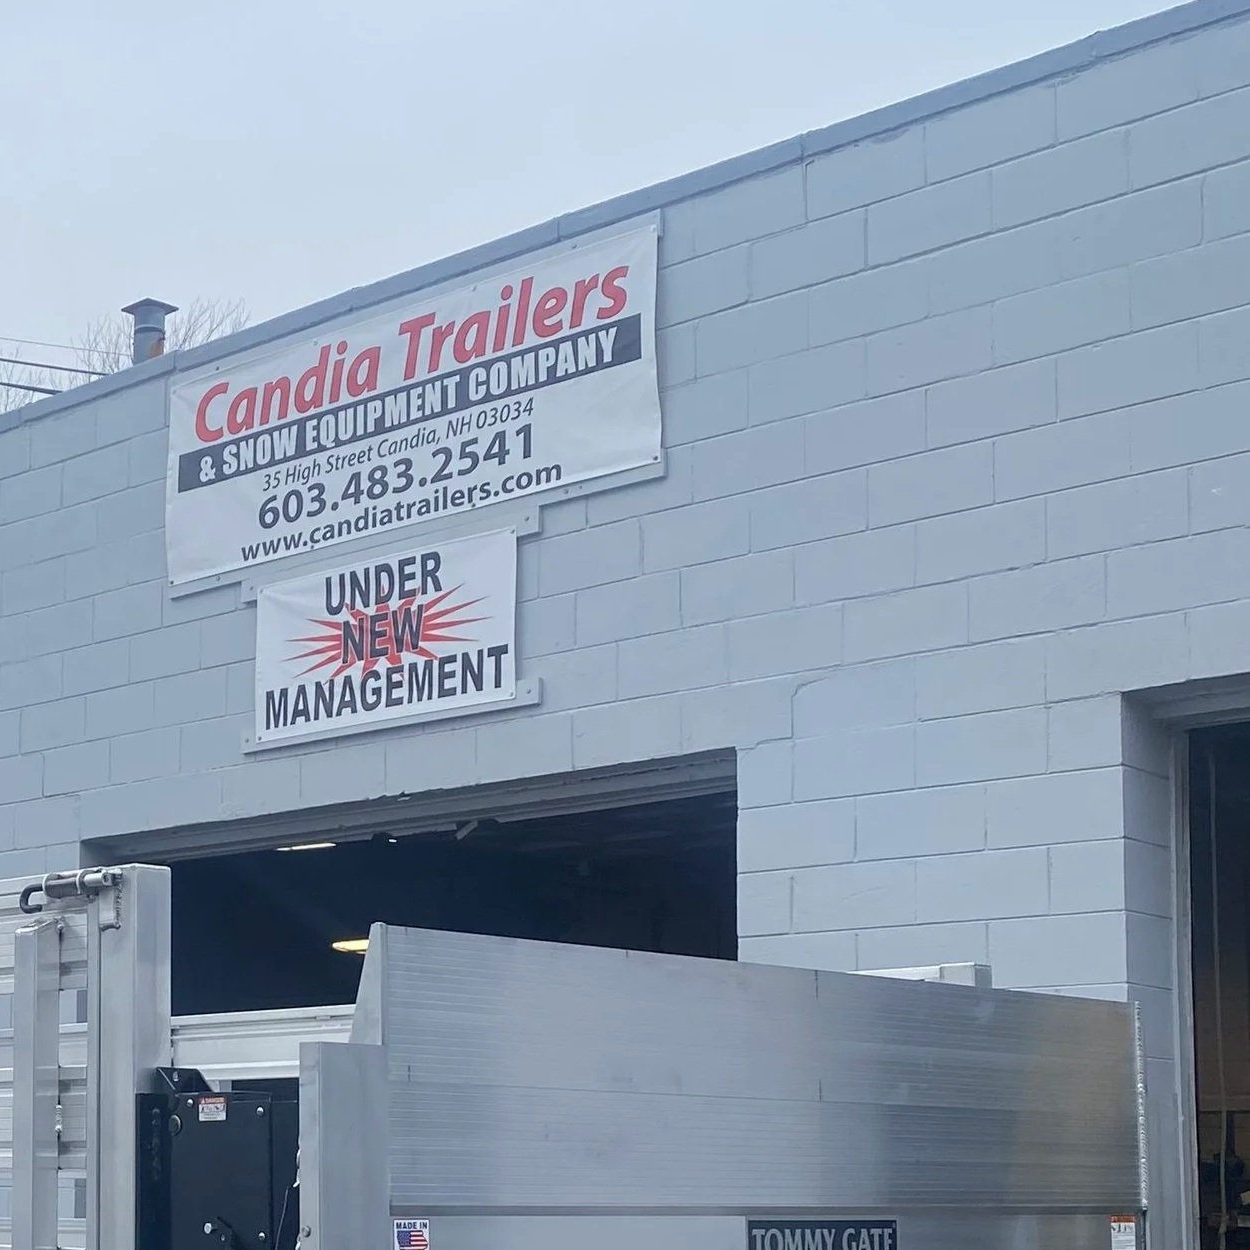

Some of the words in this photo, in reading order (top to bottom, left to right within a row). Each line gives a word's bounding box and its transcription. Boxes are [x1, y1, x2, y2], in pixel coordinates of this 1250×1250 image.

[195, 340, 382, 443] Candia
[398, 264, 630, 381] Trailers
[199, 455, 217, 483] &
[222, 433, 299, 474] SNOW
[305, 376, 460, 450] EQUIPMENT
[468, 326, 618, 402] COMPANY
[262, 471, 282, 492] 35
[285, 455, 323, 489] High
[325, 443, 374, 474] Street
[377, 427, 442, 462] Candia,
[445, 412, 473, 438] NH
[476, 398, 535, 429] 03034
[241, 461, 562, 562] www.candiatrailers.com
[258, 423, 535, 529] 603.483.2541
[325, 551, 442, 615] UNDER
[342, 604, 424, 664] NEW
[265, 644, 509, 730] MANAGEMENT
